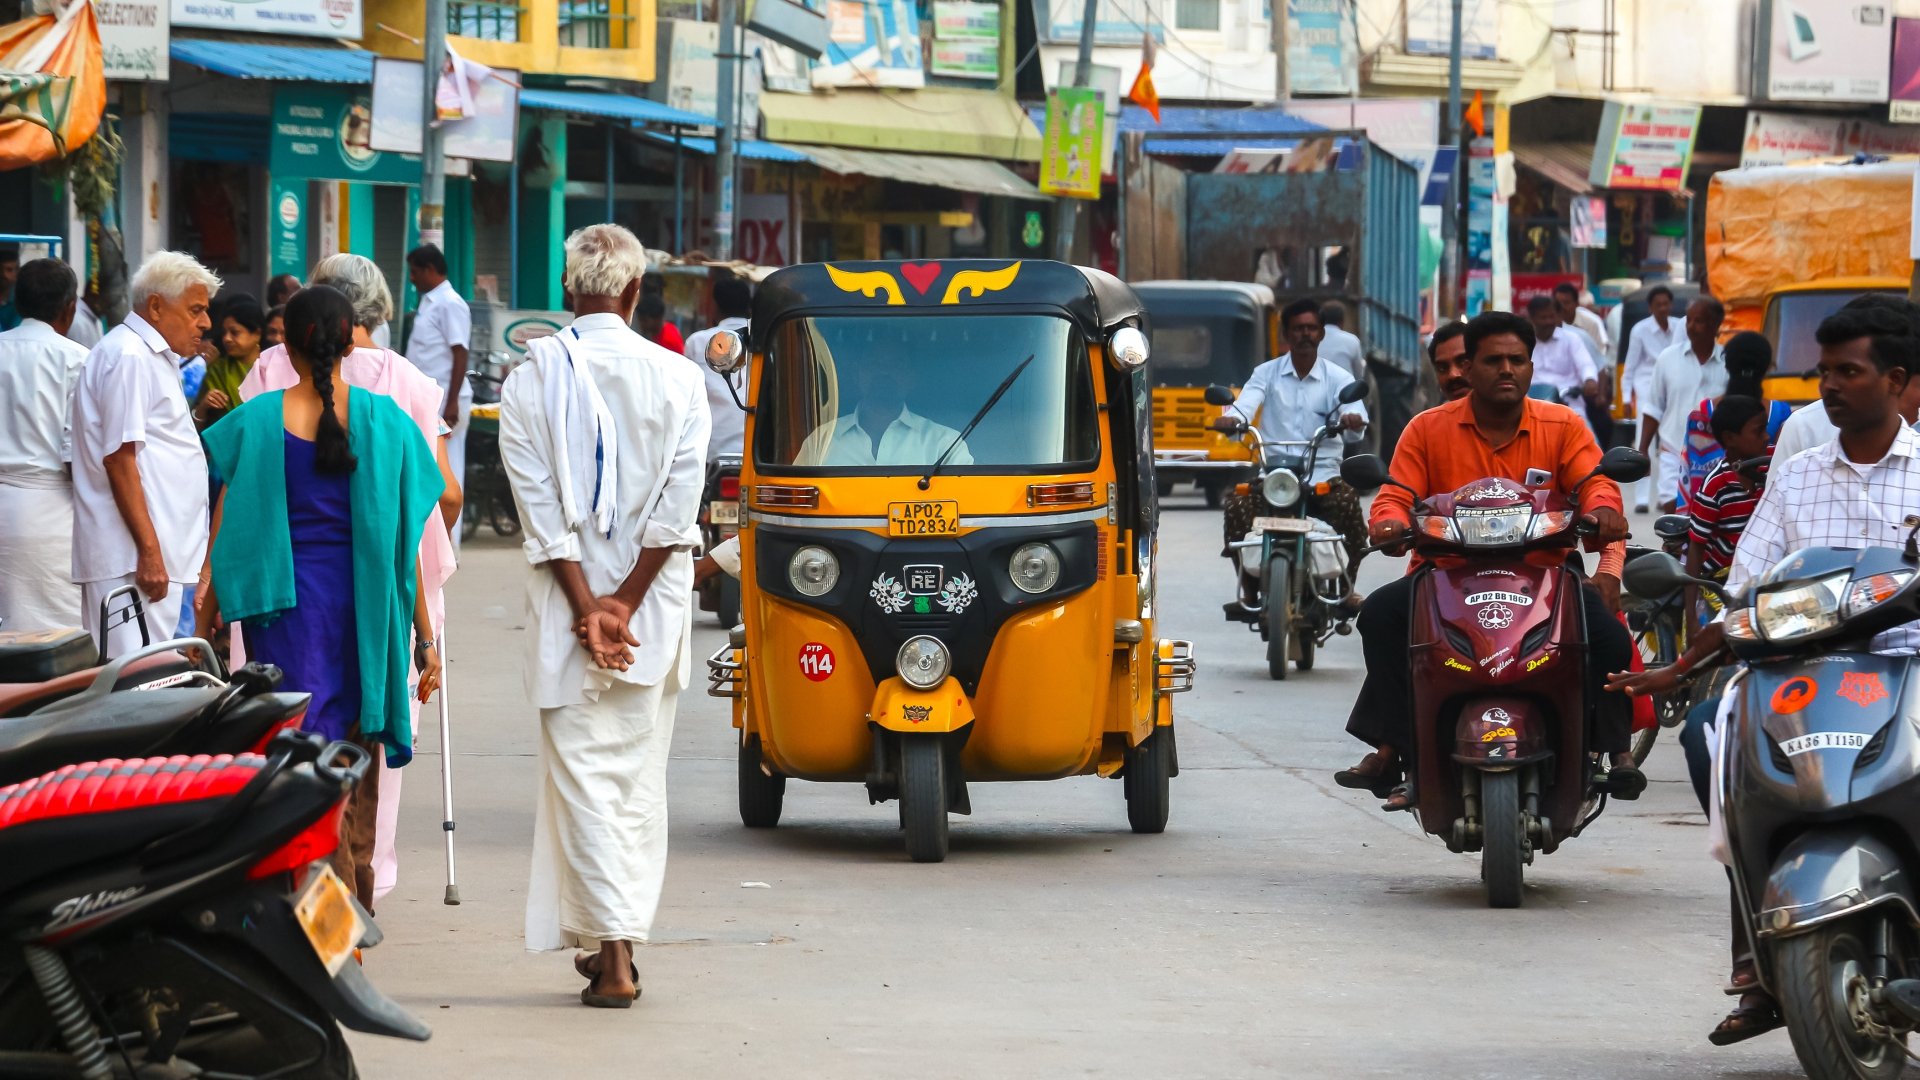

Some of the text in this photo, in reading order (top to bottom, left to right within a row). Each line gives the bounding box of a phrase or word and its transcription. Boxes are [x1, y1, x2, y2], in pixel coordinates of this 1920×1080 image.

[904, 504, 943, 518] AP02
[897, 518, 957, 534] TD2834
[1476, 569, 1517, 577] HONDA
[911, 575, 936, 589] RE
[1470, 595, 1481, 604] AP
[1482, 593, 1493, 601] 02
[1509, 594, 1528, 604] 1867
[800, 653, 833, 675] 114
[1444, 657, 1472, 672] Pavan
[1526, 652, 1550, 672] Devi
[1804, 656, 1856, 666] HONDA
[1787, 740, 1803, 753] KA
[1804, 736, 1820, 747] 36
[44, 886, 147, 932] Shine
